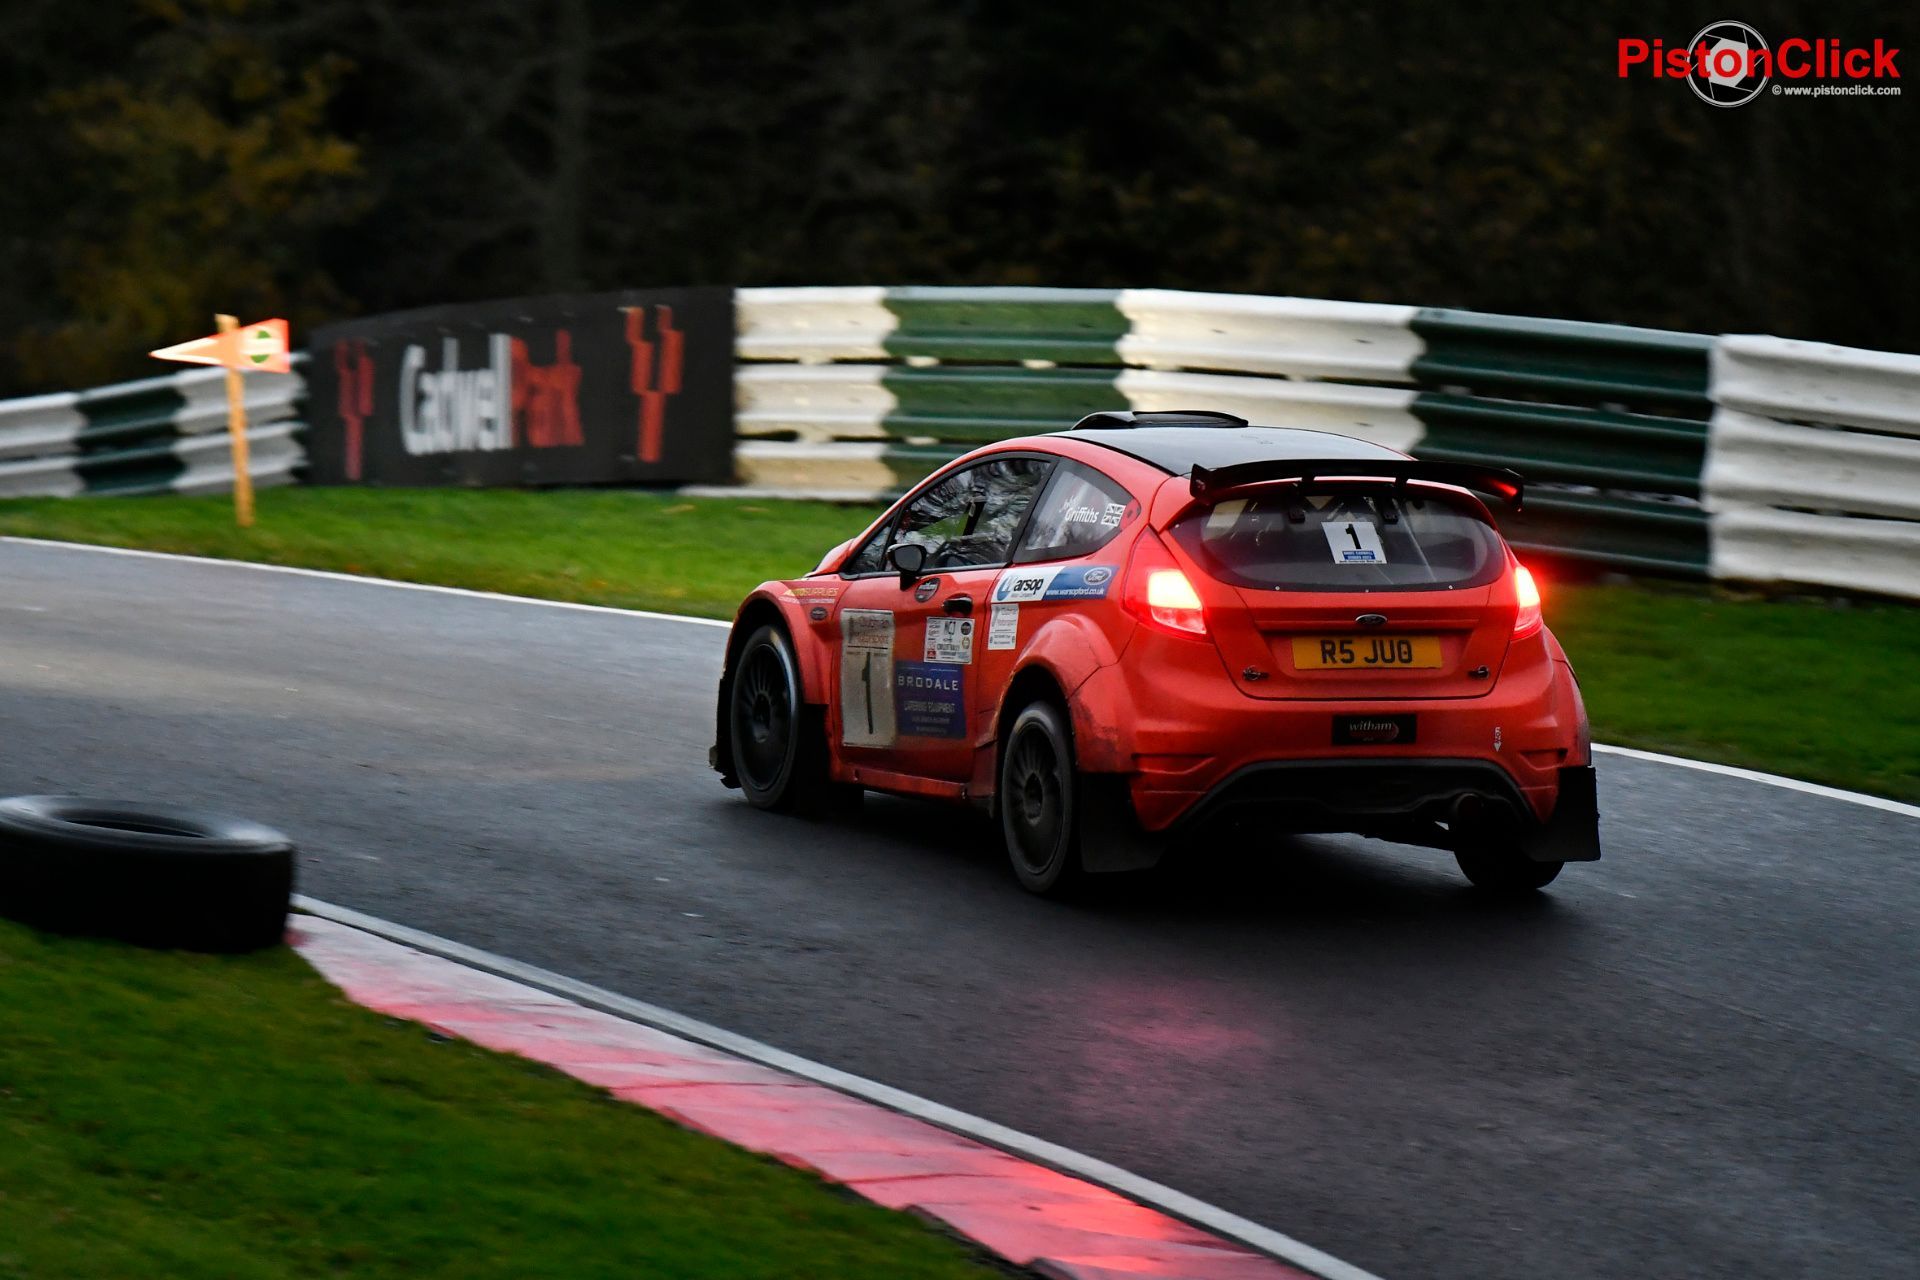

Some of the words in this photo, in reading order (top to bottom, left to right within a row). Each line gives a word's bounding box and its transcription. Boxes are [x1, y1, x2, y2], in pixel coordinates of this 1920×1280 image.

[508, 329, 586, 449] Park
[1064, 507, 1100, 524] Griffiths
[1345, 523, 1362, 550] 1
[1320, 639, 1356, 664] R5
[861, 652, 874, 735] 1
[898, 675, 959, 691] BRODALE
[1350, 719, 1392, 731] witham
